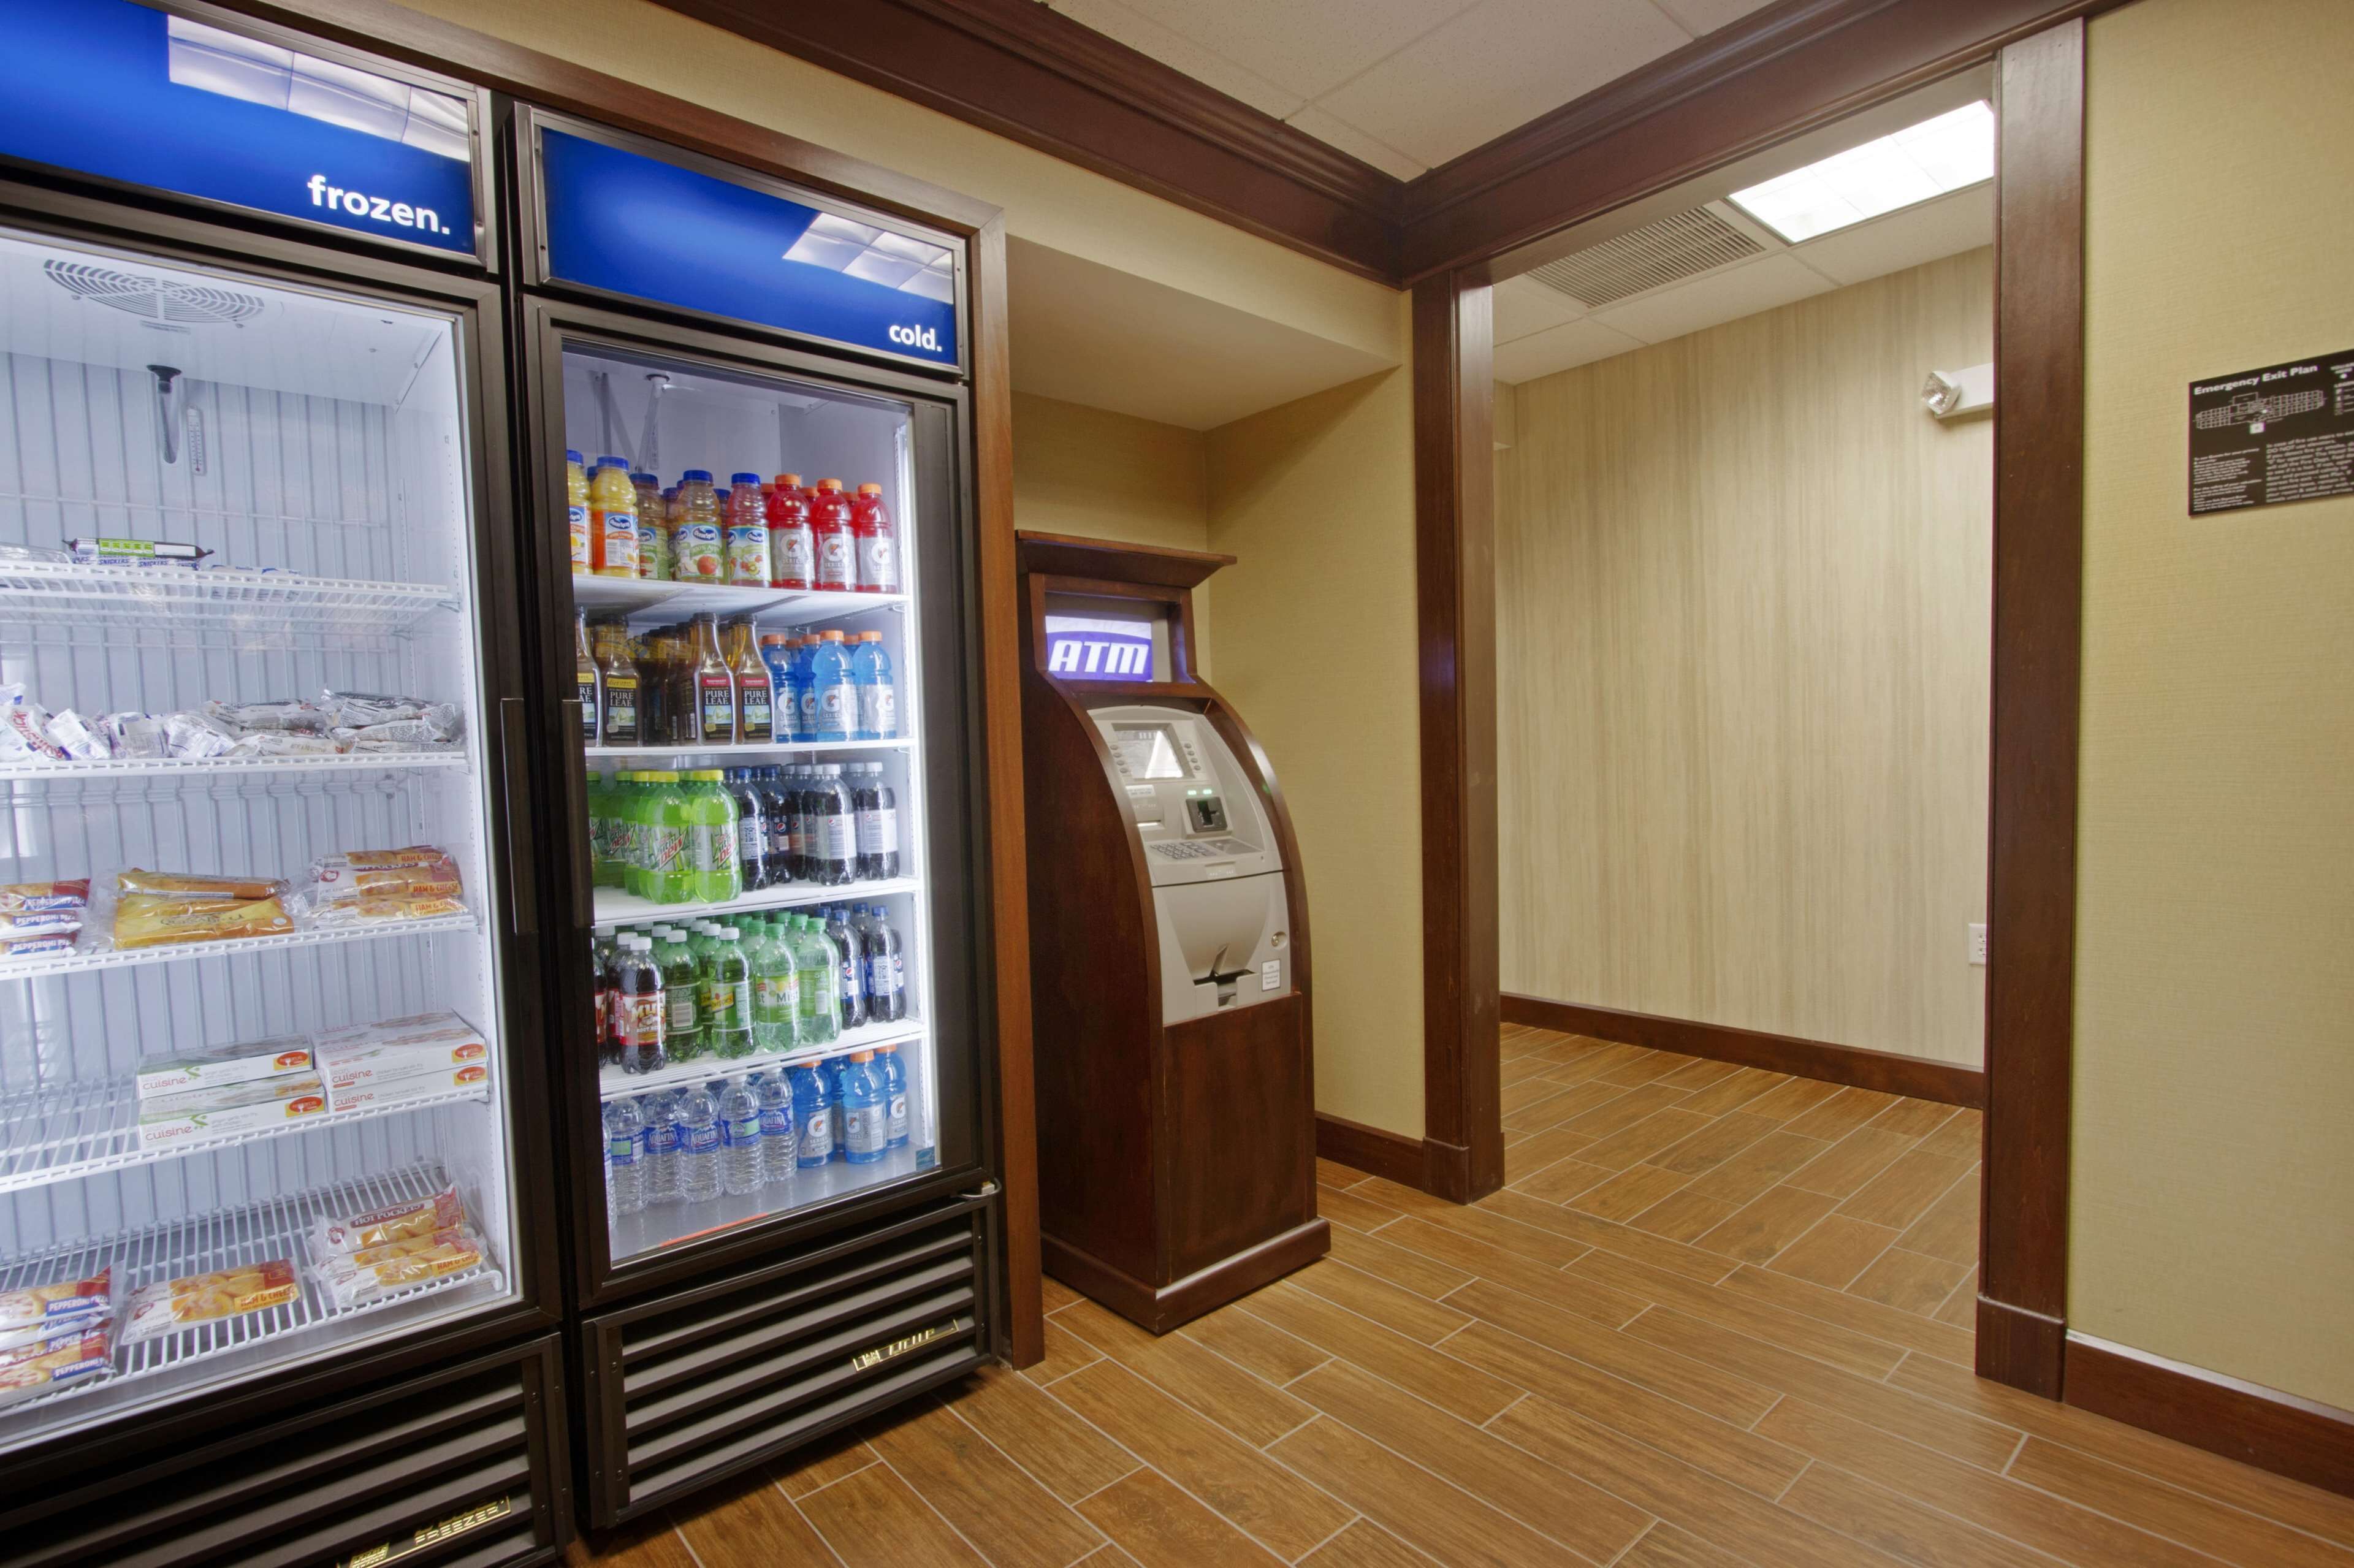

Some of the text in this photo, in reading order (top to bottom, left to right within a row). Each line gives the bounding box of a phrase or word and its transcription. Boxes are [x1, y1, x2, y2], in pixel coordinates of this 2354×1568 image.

[308, 175, 450, 234] frozen.
[889, 324, 942, 352] cold.
[2194, 376, 2260, 395] Emergency
[2262, 370, 2287, 381] Exit
[2290, 365, 2318, 376] Plan
[1048, 639, 1149, 674] ATM
[610, 691, 633, 699] PURE
[142, 1076, 187, 1090] cuisine
[332, 1070, 373, 1083] cuisine
[334, 1093, 374, 1106] cuisine
[145, 1125, 192, 1141] cuisine
[354, 1204, 421, 1225] HOT POCKETS
